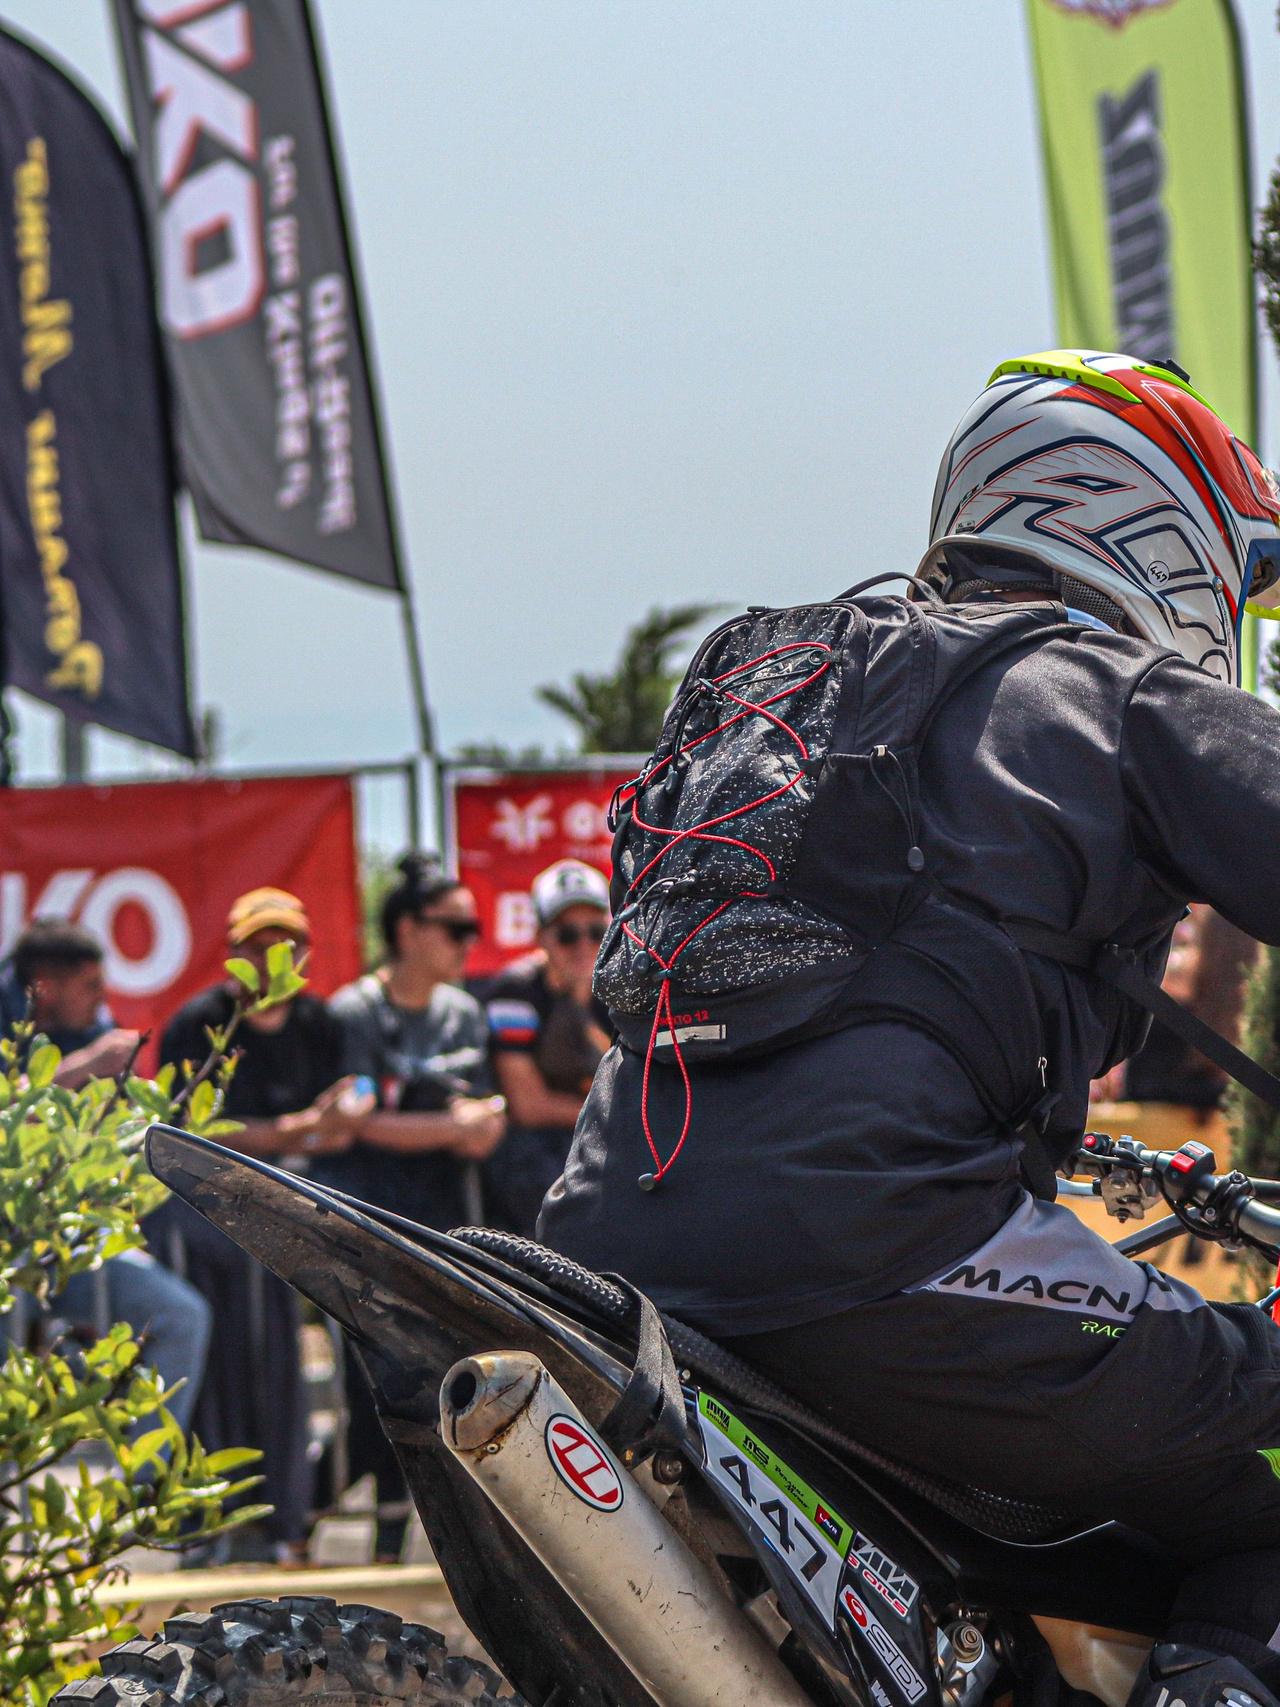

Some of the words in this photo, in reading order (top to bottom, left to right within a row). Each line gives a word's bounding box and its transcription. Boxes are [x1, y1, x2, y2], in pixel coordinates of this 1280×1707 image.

[1150, 566, 1168, 583] 447
[695, 1010, 709, 1022] 12
[719, 1454, 827, 1582] 447
[863, 1569, 908, 1617] OILS
